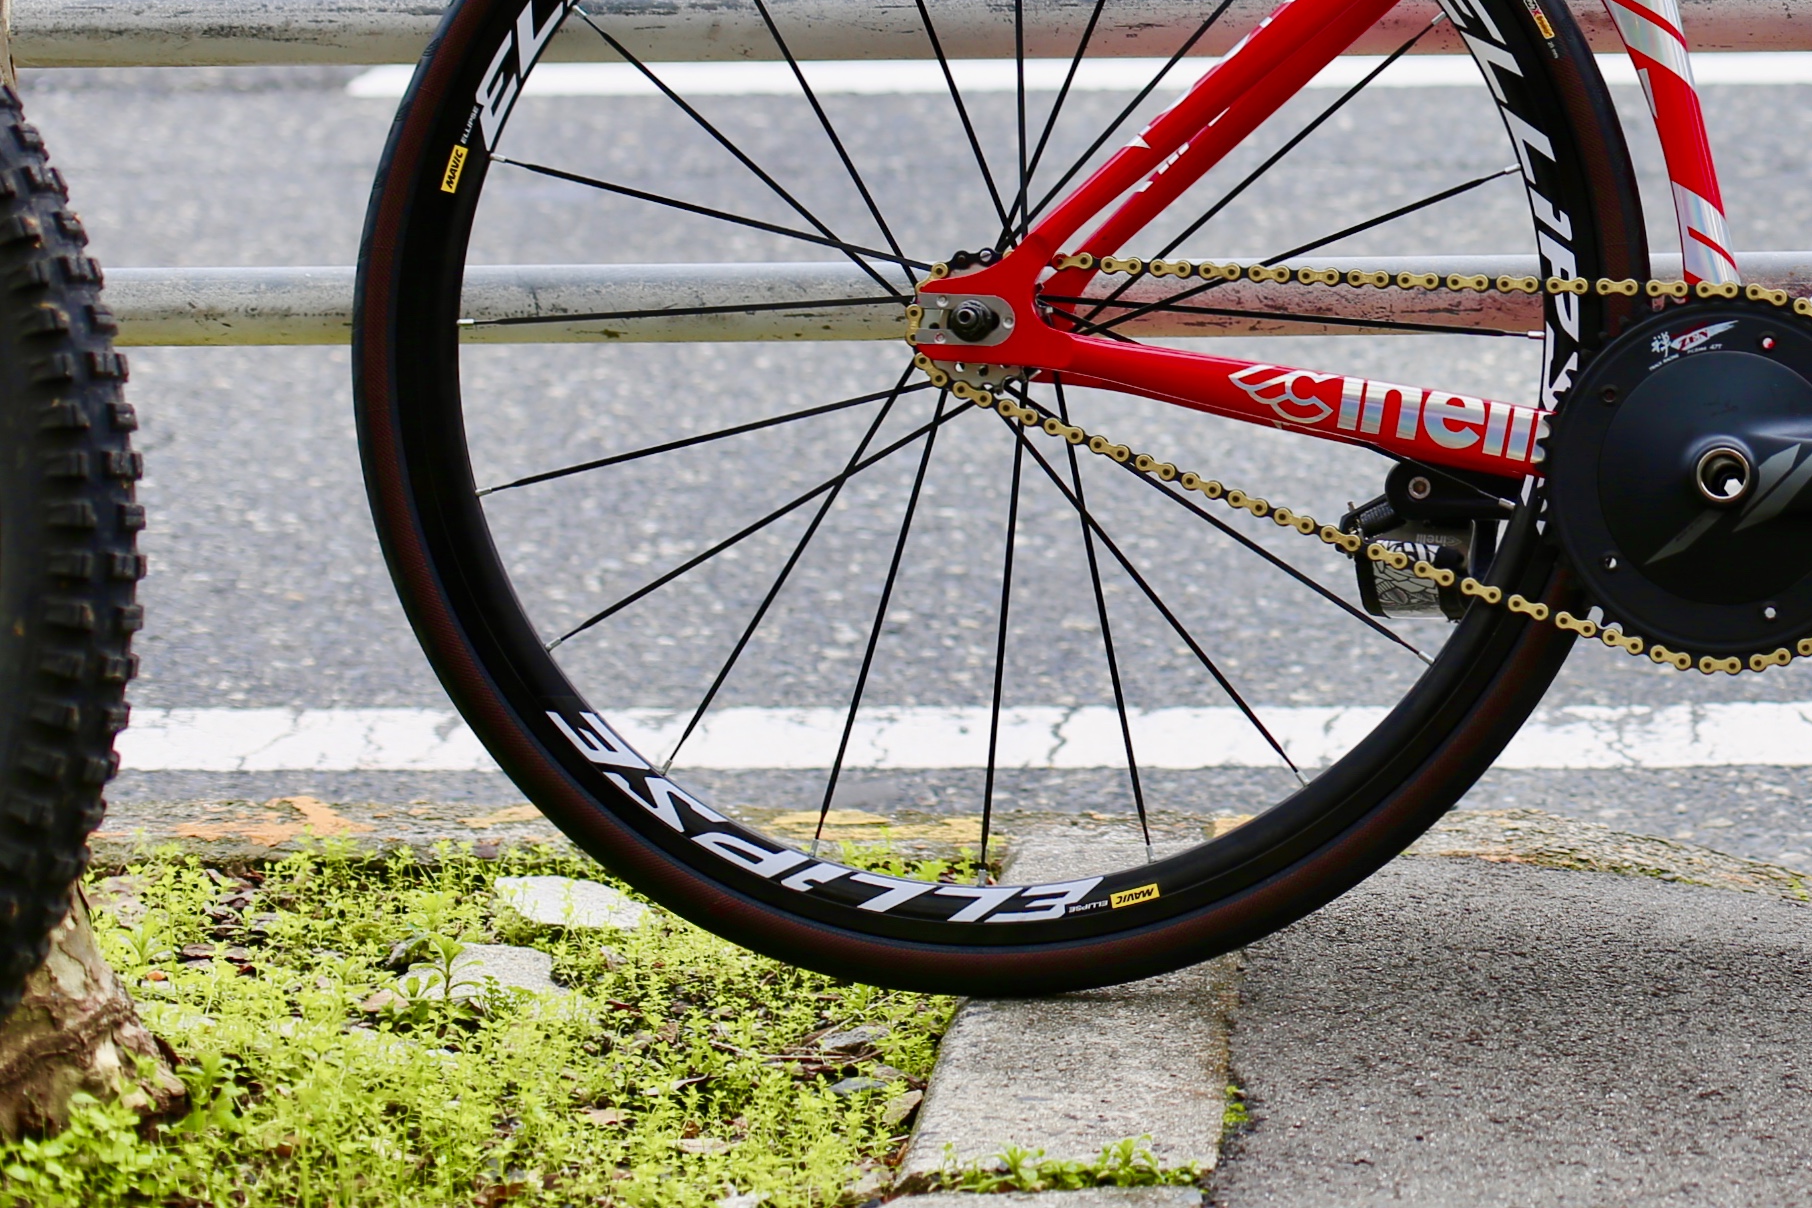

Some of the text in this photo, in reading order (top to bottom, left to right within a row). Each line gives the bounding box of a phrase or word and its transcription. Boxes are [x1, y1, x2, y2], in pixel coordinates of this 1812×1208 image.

[443, 105, 480, 190] MAVIC ELLIPSE
[1679, 328, 1710, 351] ZEN
[545, 710, 1104, 924] ELLIPSE
[1067, 885, 1157, 914] MAVIC ELLIPSE
